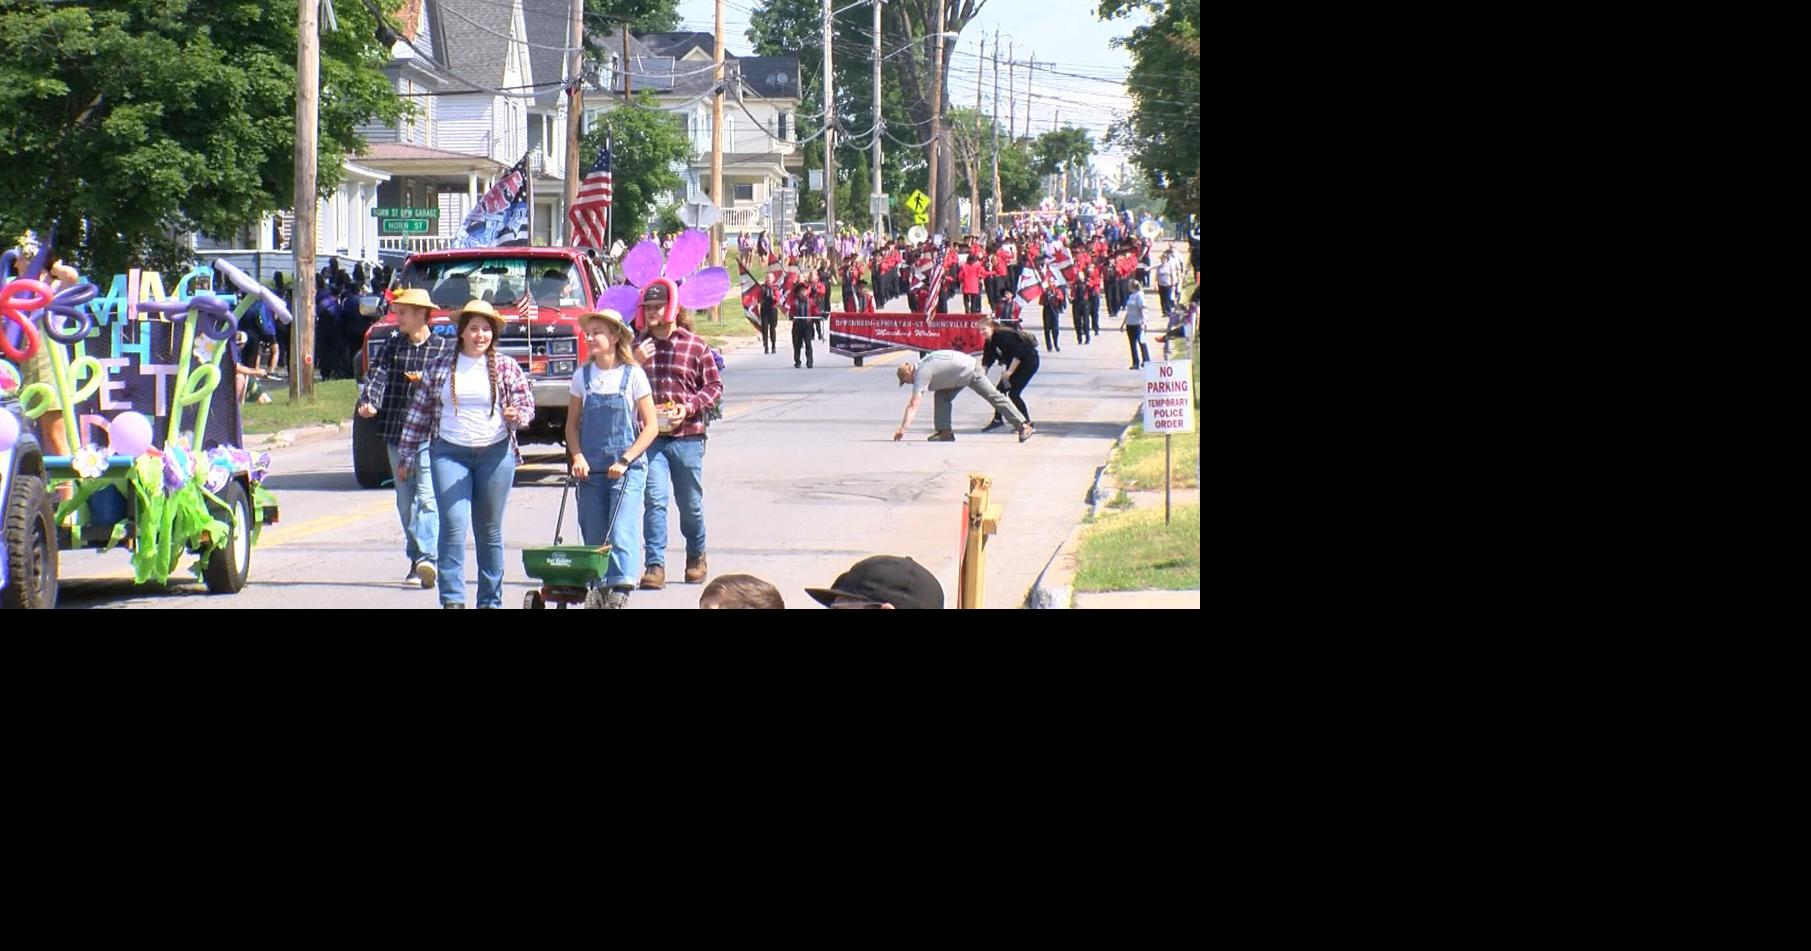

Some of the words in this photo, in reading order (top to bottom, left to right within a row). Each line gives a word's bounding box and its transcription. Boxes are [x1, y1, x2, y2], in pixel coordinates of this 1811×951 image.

[1159, 366, 1173, 377] NO
[1147, 380, 1188, 393] PARKING
[1148, 398, 1189, 408] TEMPORARY
[1154, 409, 1184, 418] POLICE
[1154, 420, 1184, 429] ORDER
